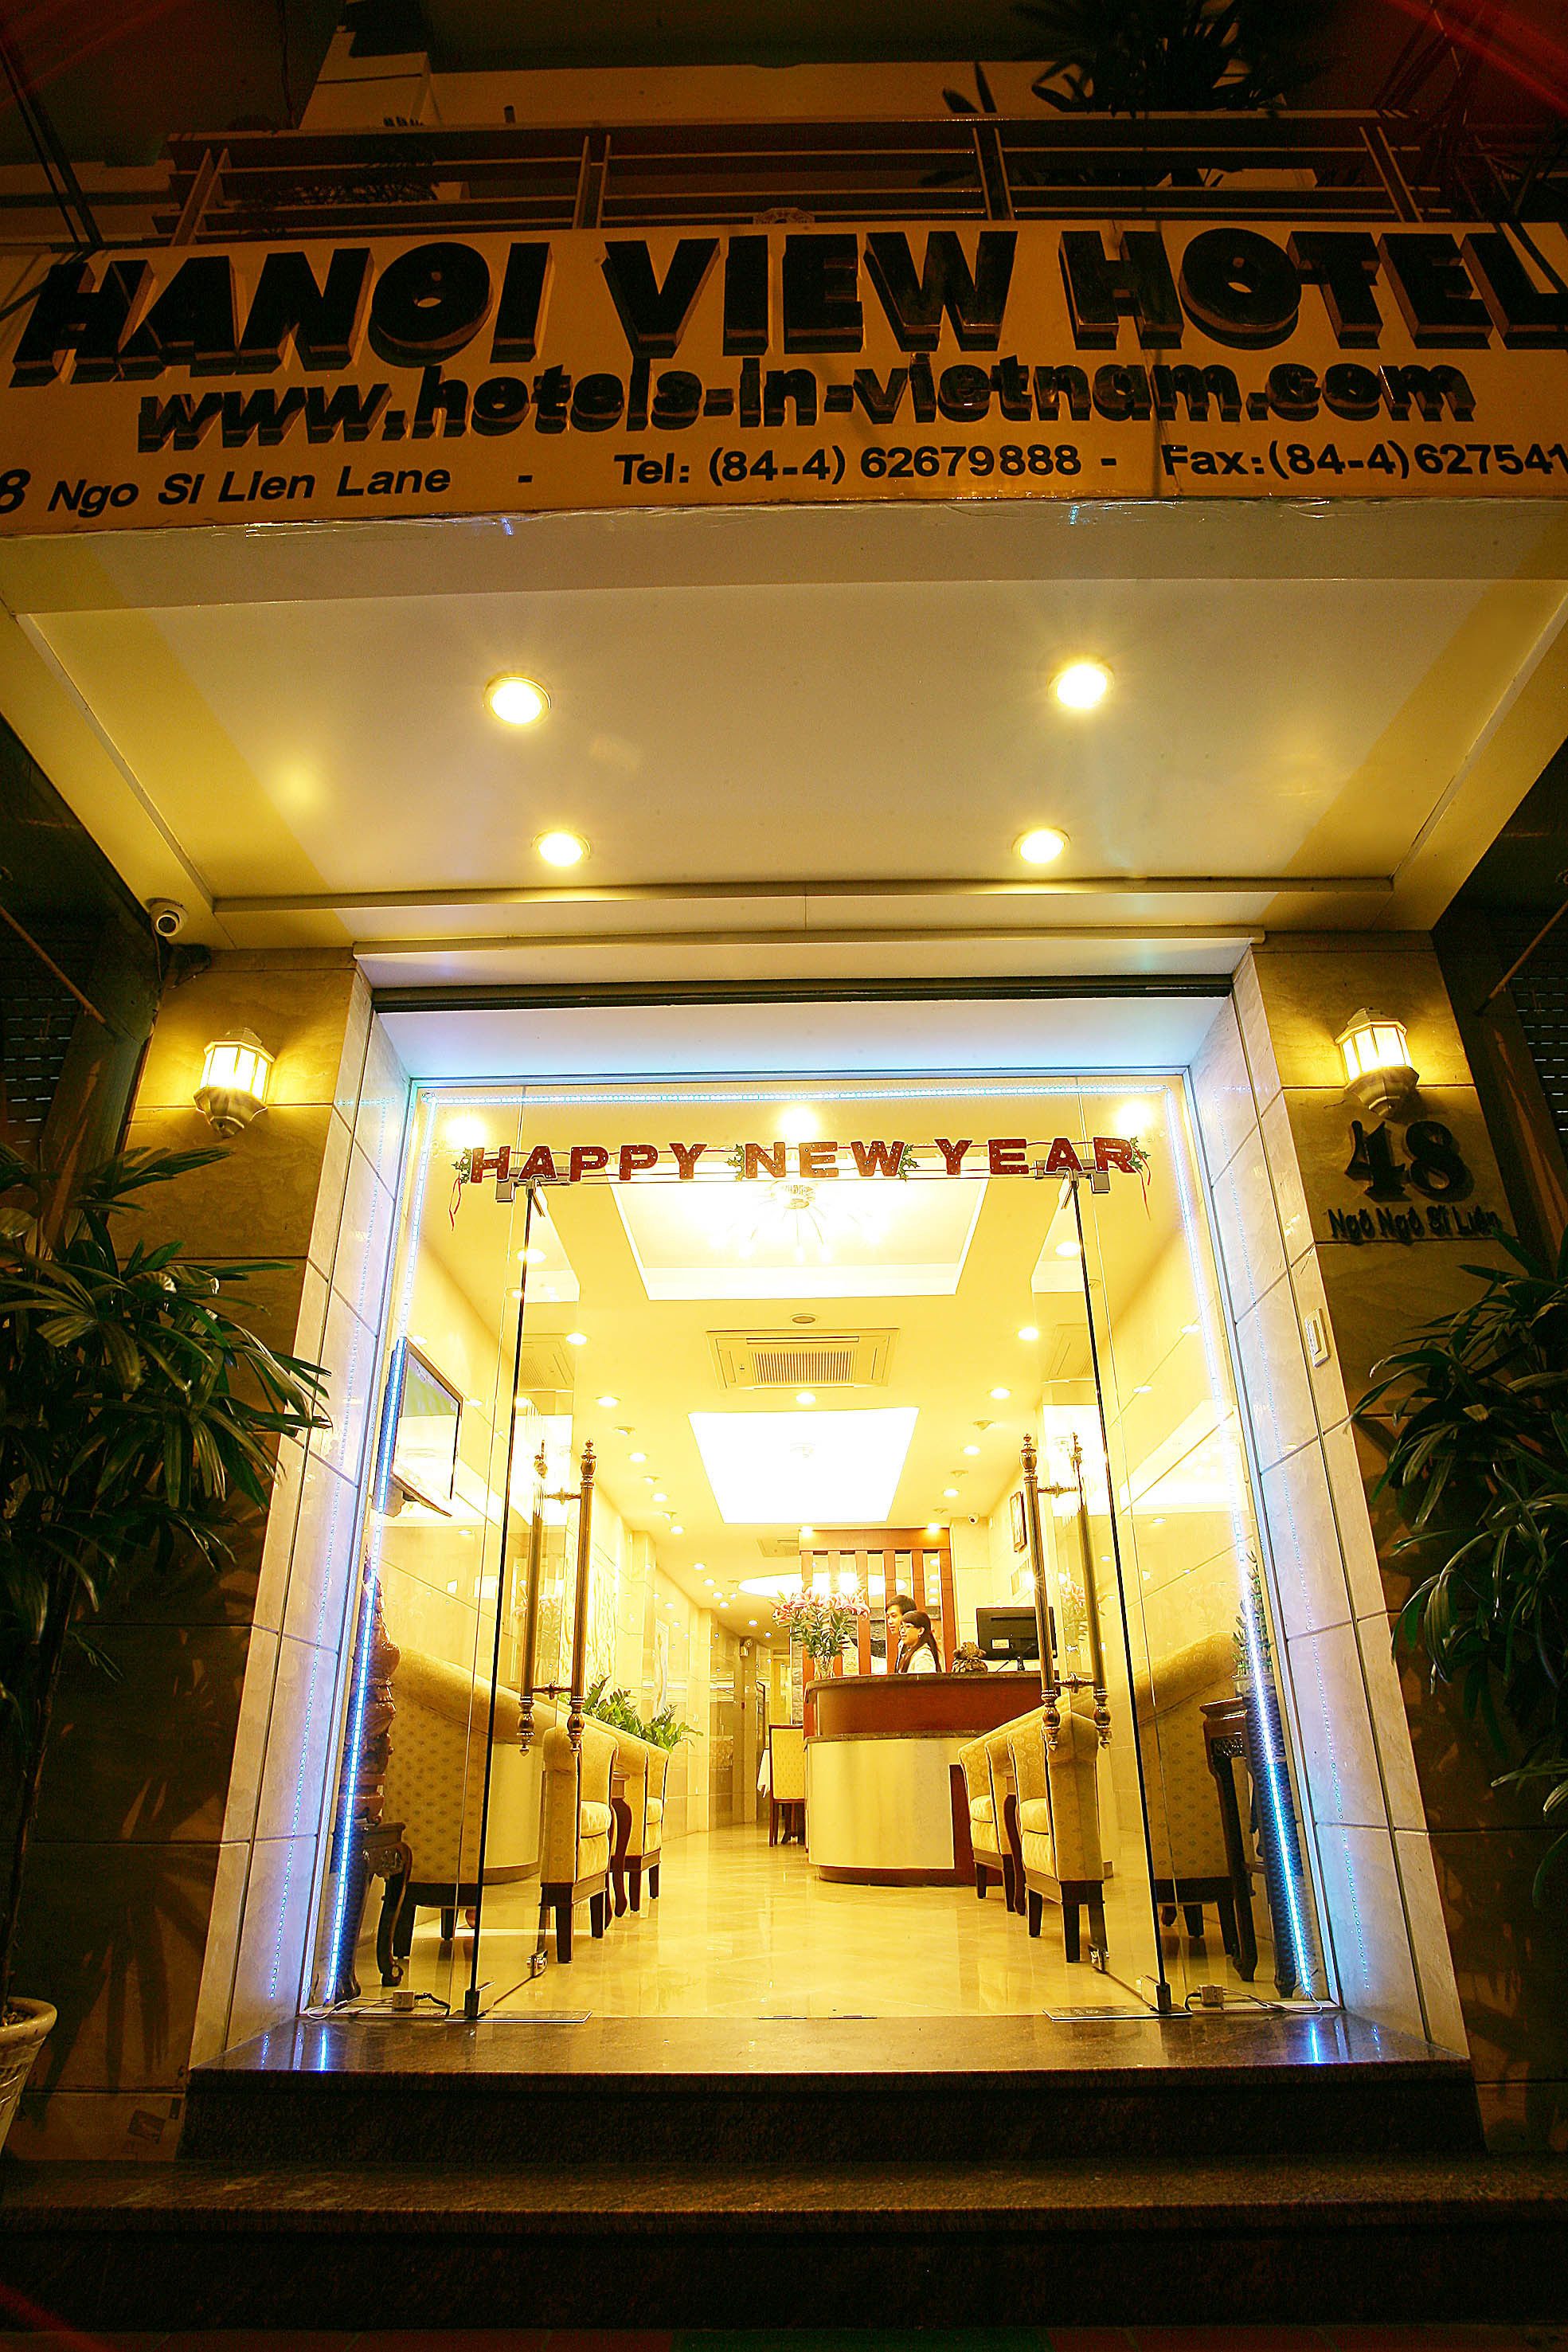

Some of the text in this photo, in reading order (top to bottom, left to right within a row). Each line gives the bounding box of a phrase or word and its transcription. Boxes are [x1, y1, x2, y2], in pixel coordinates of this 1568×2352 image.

[10, 228, 1568, 388] HANOI VIEW HOTEL
[138, 353, 1476, 452] www.hotels-in-vietnam.com
[47, 479, 139, 518] Ngo
[336, 465, 452, 497] Lane
[614, 452, 690, 486] Tel:
[709, 445, 846, 486] (84-4)
[860, 444, 1081, 479] 62679888
[470, 1137, 1137, 1184] HAPPY NEW YEAR
[1344, 1120, 1473, 1203] 48
